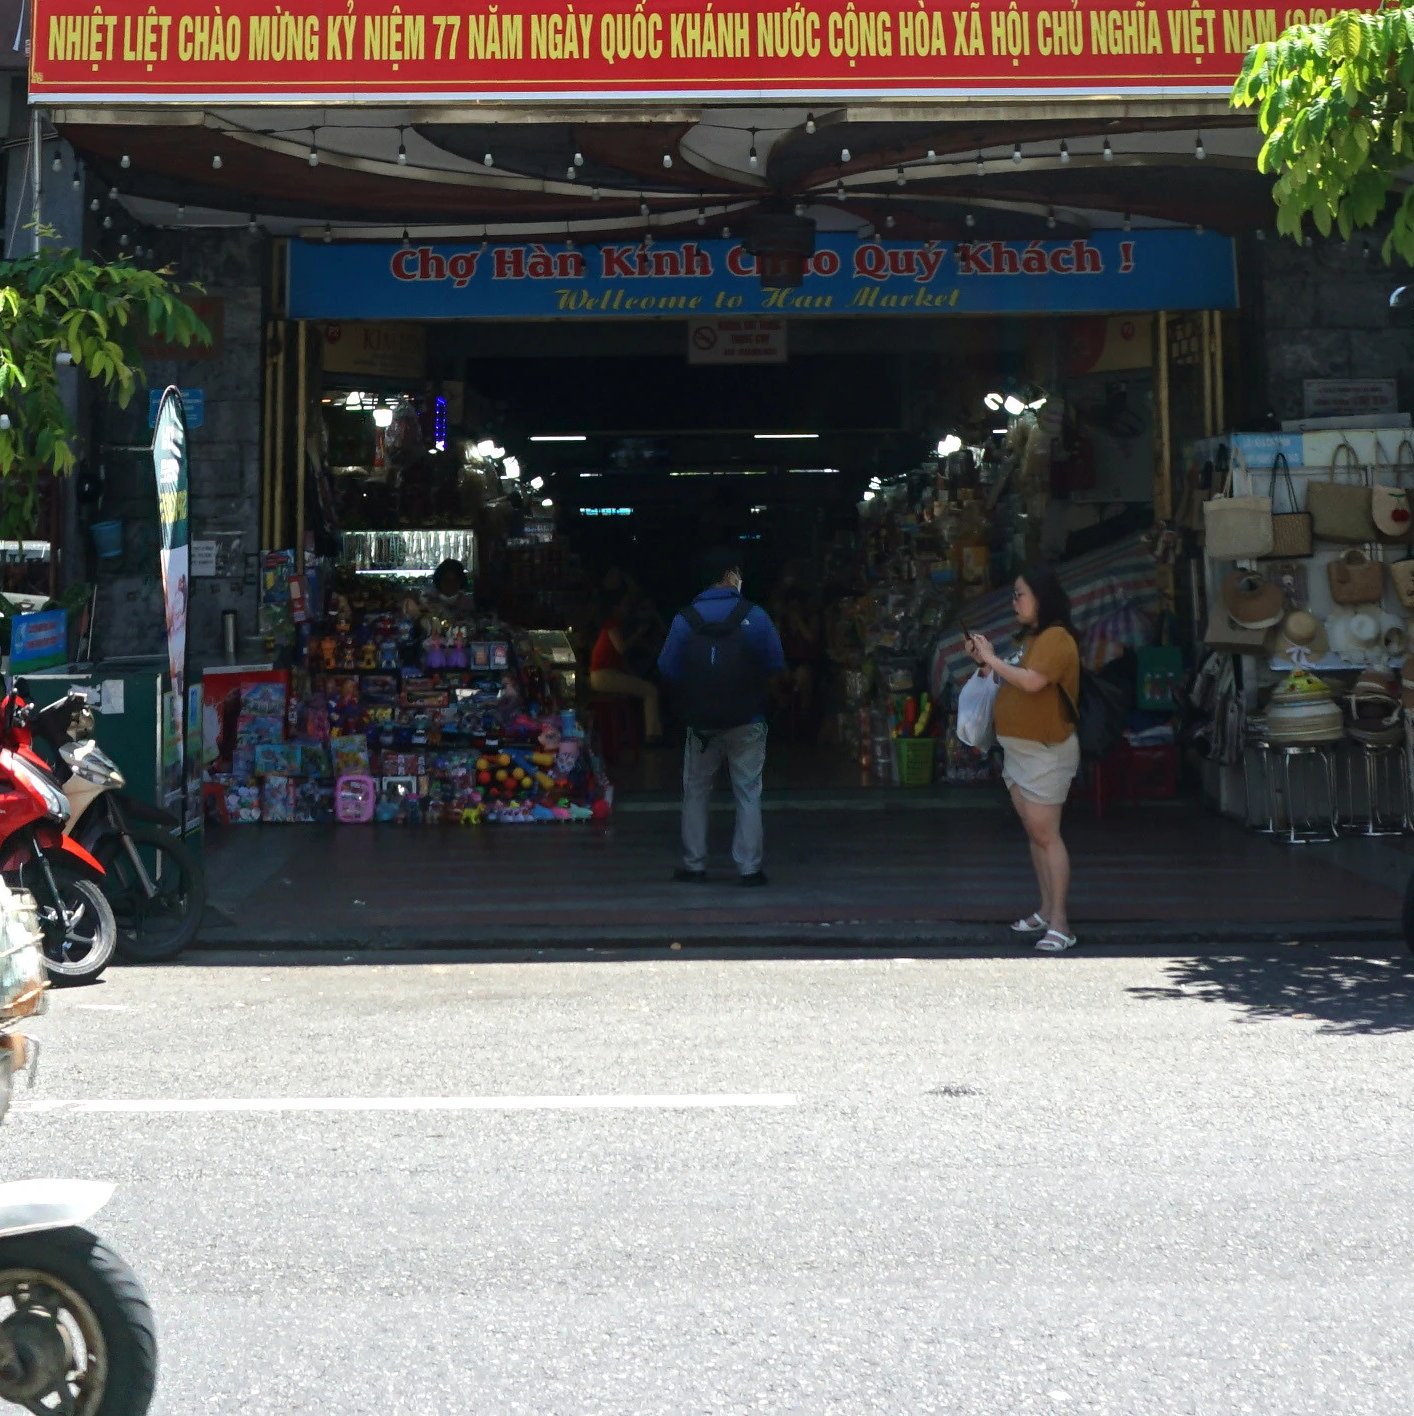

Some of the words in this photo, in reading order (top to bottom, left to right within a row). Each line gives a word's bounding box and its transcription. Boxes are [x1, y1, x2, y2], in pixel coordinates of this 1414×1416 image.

[48, 5, 118, 72] NHIỆT
[123, 5, 173, 72] LIỆT
[178, 5, 242, 62] CHÀO
[248, 5, 320, 62] MỪNG
[326, 0, 358, 61] KỶ
[364, 5, 425, 71] NIỆM
[432, 15, 461, 61] 77
[468, 4, 523, 61] NĂM
[530, 3, 594, 60] NGÀY
[670, 2, 750, 59] KHÁNH
[757, 1, 821, 58] NƯỚC
[828, 2, 892, 68] CỘNG
[899, 0, 947, 57] HÒA
[953, 2, 985, 56] XÃ
[991, 1, 1030, 67] HỘI
[1091, 1, 1163, 55] NGHĨA
[1167, 0, 1216, 64] VIỆT
[1222, 9, 1278, 54] NAM
[390, 246, 481, 289] Chợ
[491, 243, 585, 281] Hàn
[601, 241, 714, 279] Kính
[852, 241, 947, 284] Quý
[954, 239, 1105, 276] Khách
[714, 291, 744, 310] to
[844, 285, 961, 310] Market
